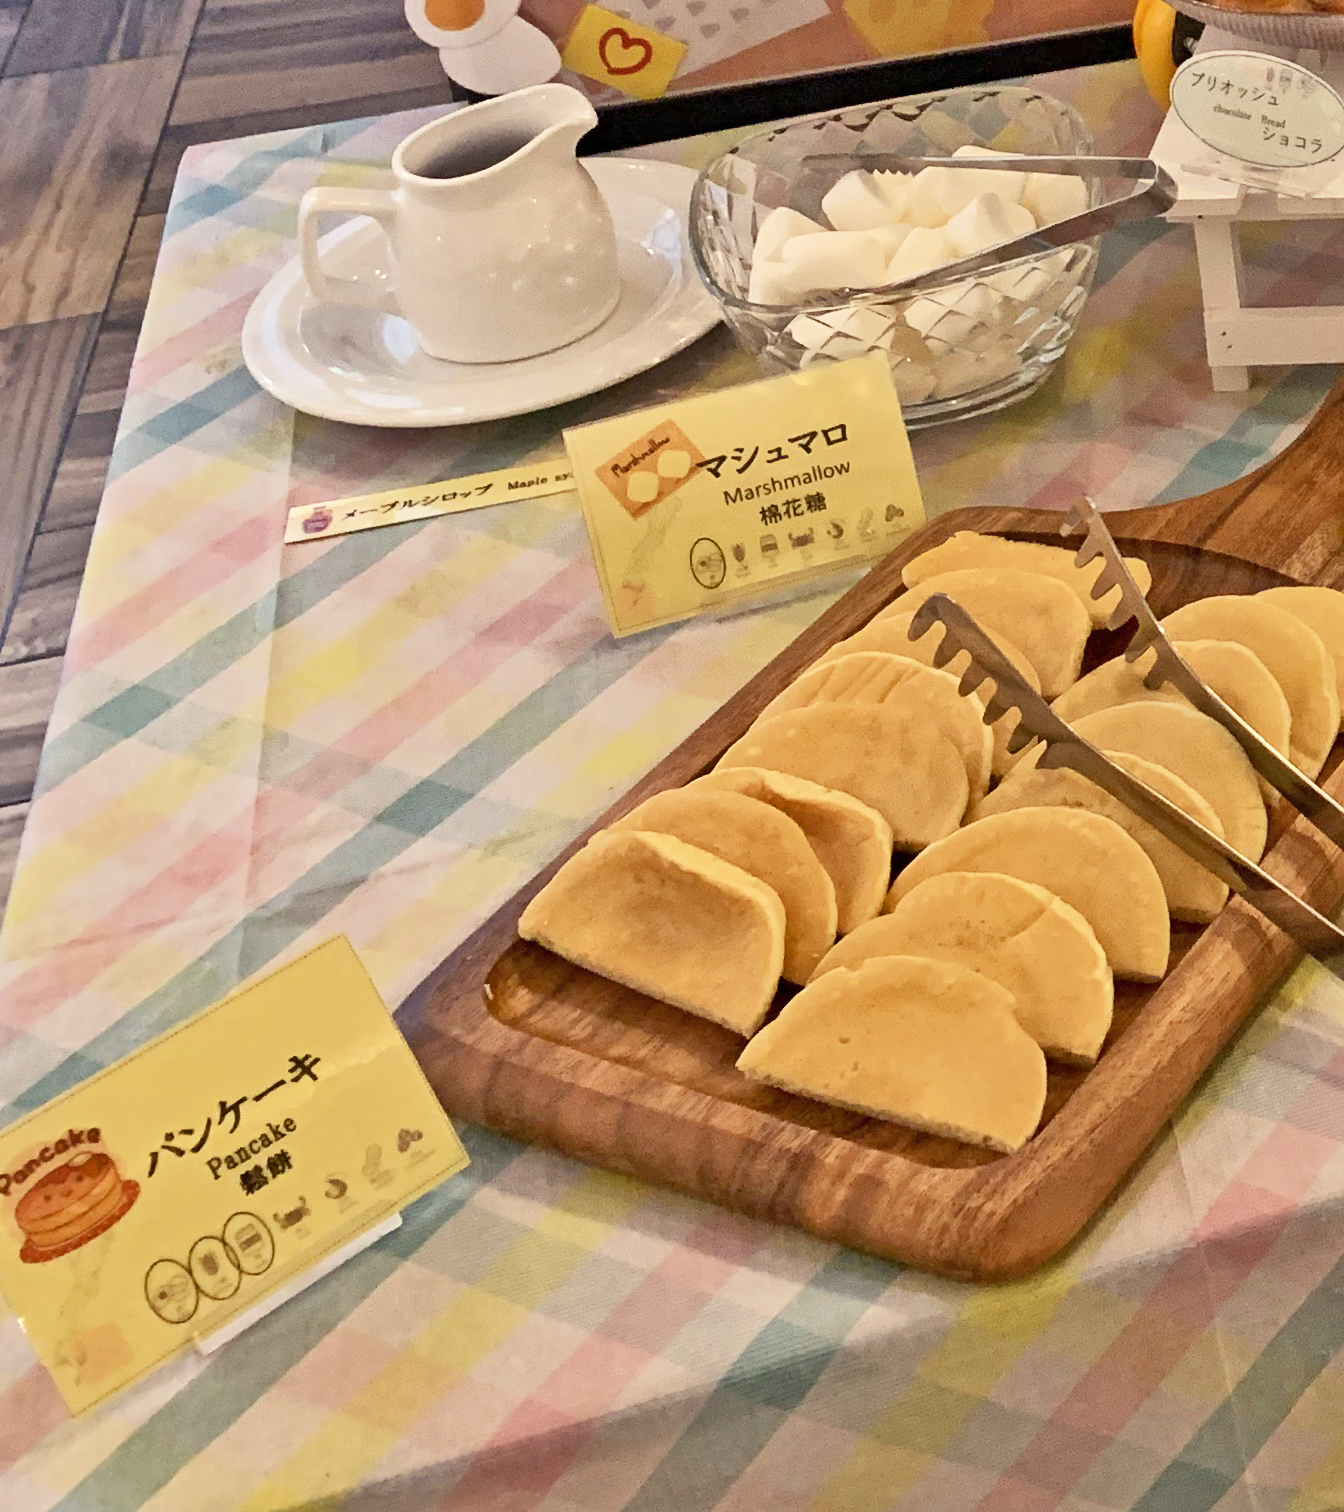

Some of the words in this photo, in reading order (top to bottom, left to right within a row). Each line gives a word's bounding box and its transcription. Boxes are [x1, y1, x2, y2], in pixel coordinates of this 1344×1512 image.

[1262, 127, 1323, 154] ショコラ
[695, 423, 849, 479] マシュマロ
[507, 476, 548, 491] Maple
[723, 459, 851, 506] Marshmallow
[759, 491, 828, 526] 棉花糖
[147, 1053, 322, 1179] パンケーキ
[205, 1116, 298, 1181] Pancake
